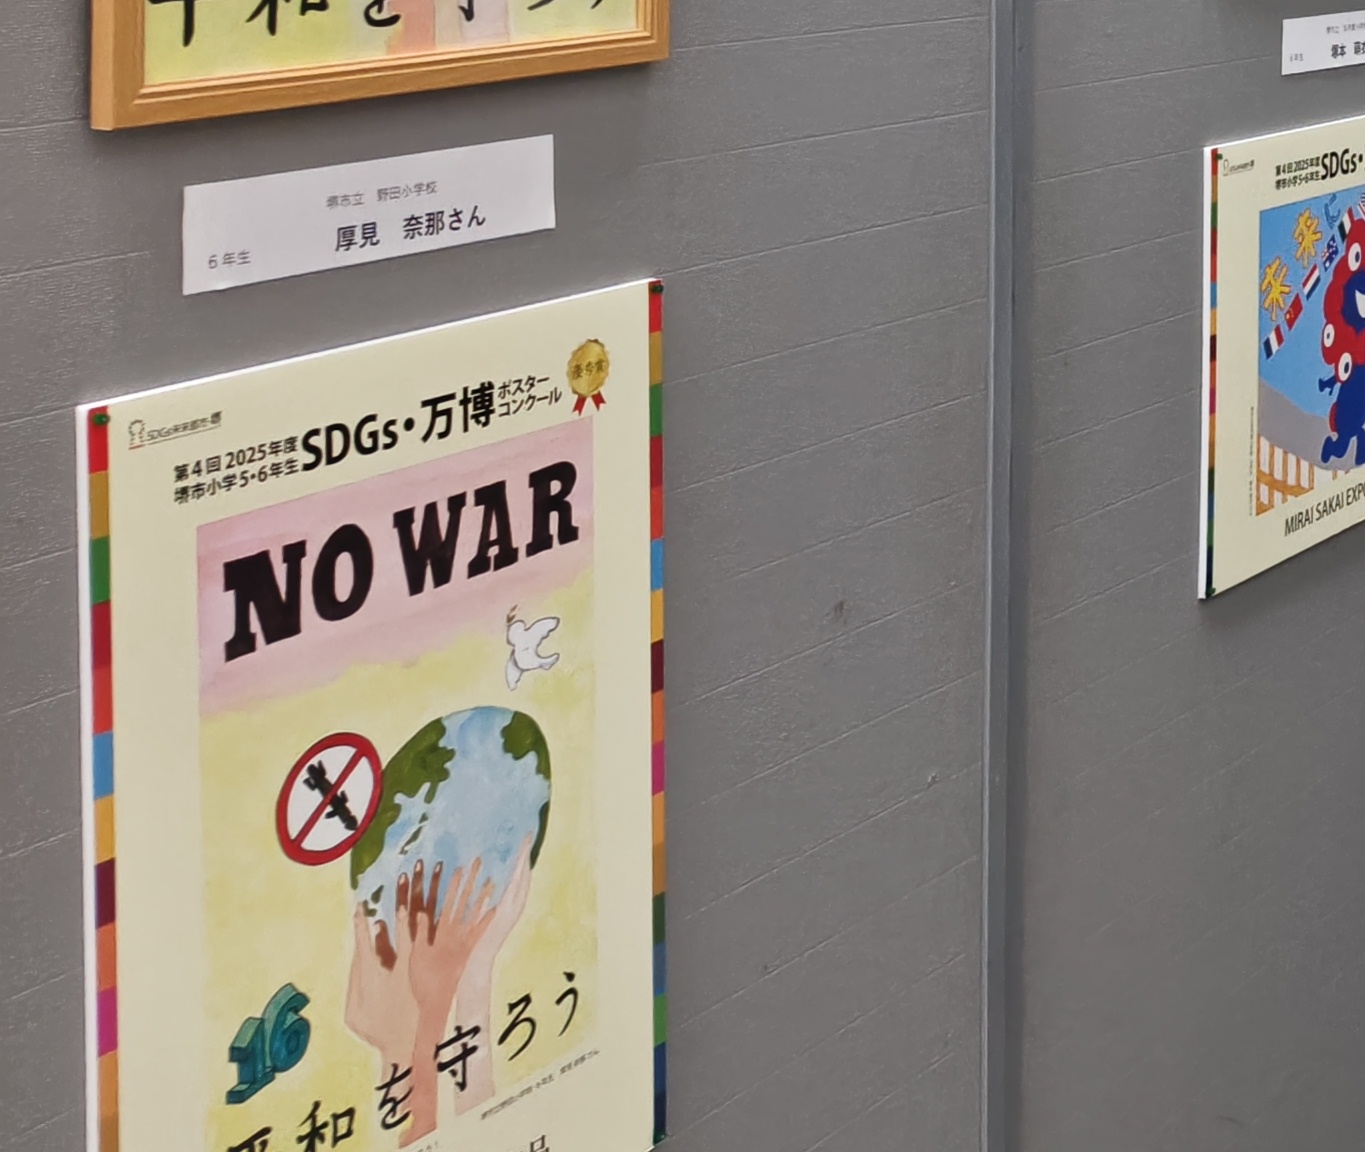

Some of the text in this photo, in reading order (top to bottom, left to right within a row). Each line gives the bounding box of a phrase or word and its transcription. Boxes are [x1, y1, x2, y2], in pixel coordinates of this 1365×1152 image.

[335, 205, 487, 252] 厚見 奈那さん
[497, 375, 550, 400] ポスター
[497, 387, 563, 418] コンクール
[301, 381, 498, 473] SDGs・万博
[1284, 504, 1314, 537] MIRAI
[1315, 491, 1344, 522] SAKAI
[223, 460, 580, 664] NO WAR
[225, 982, 311, 1105] 16
